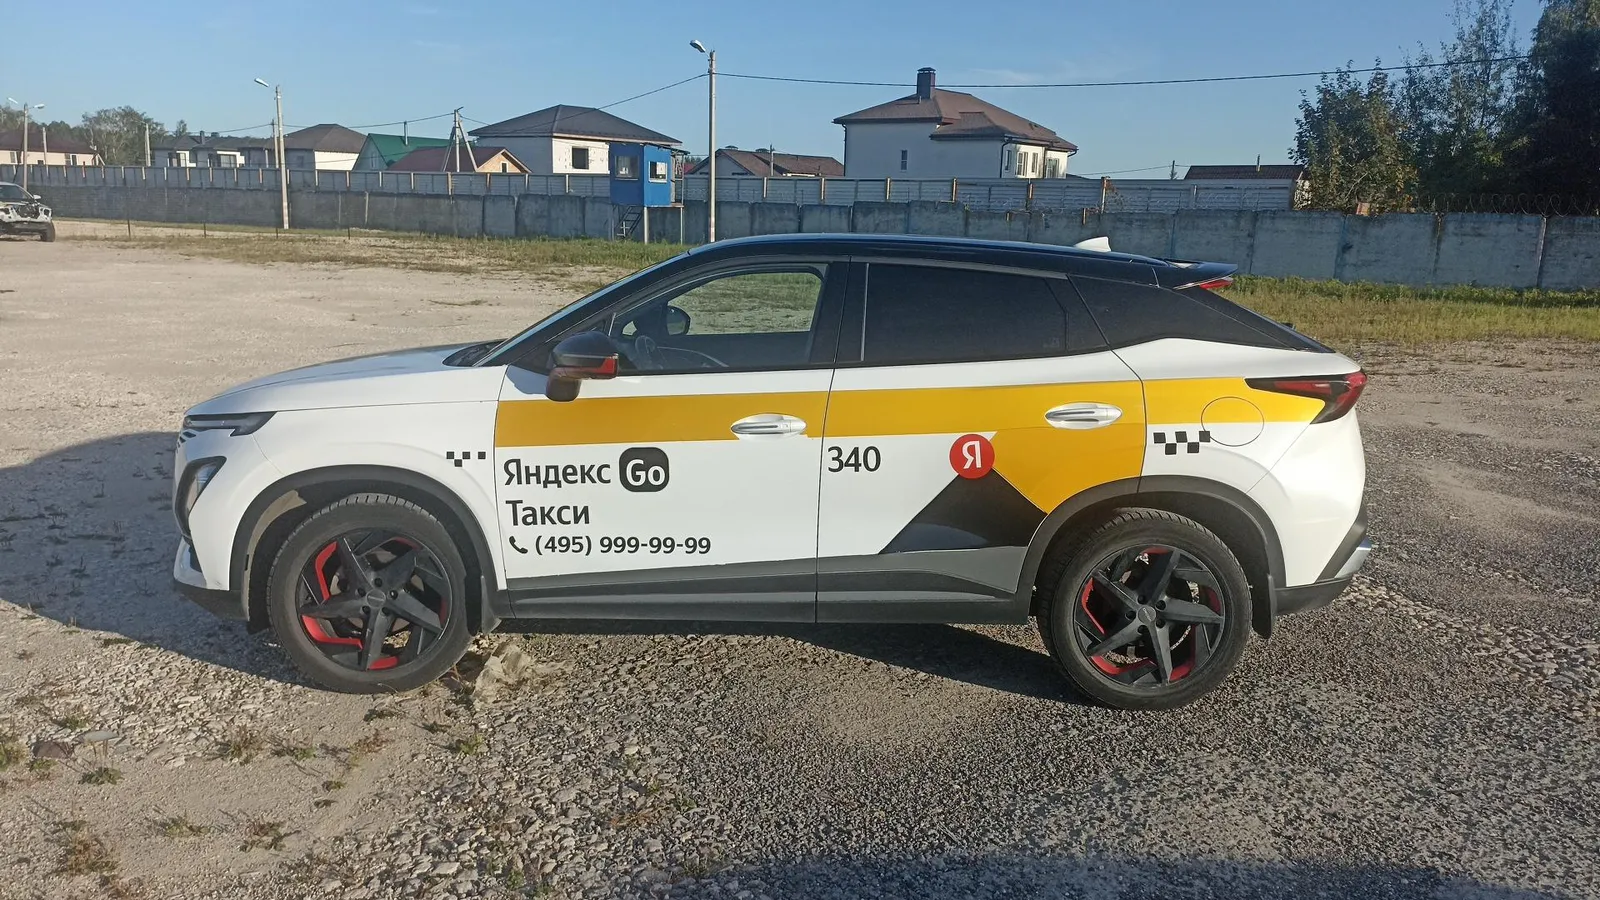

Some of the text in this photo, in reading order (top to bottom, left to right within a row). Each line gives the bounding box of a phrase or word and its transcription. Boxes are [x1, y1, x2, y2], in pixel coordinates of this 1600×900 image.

[827, 446, 882, 473] 340
[961, 440, 983, 470] Я
[503, 458, 667, 489] Яндекс Go
[505, 499, 591, 527] Такси
[535, 535, 712, 556] (495) 999-99-99
